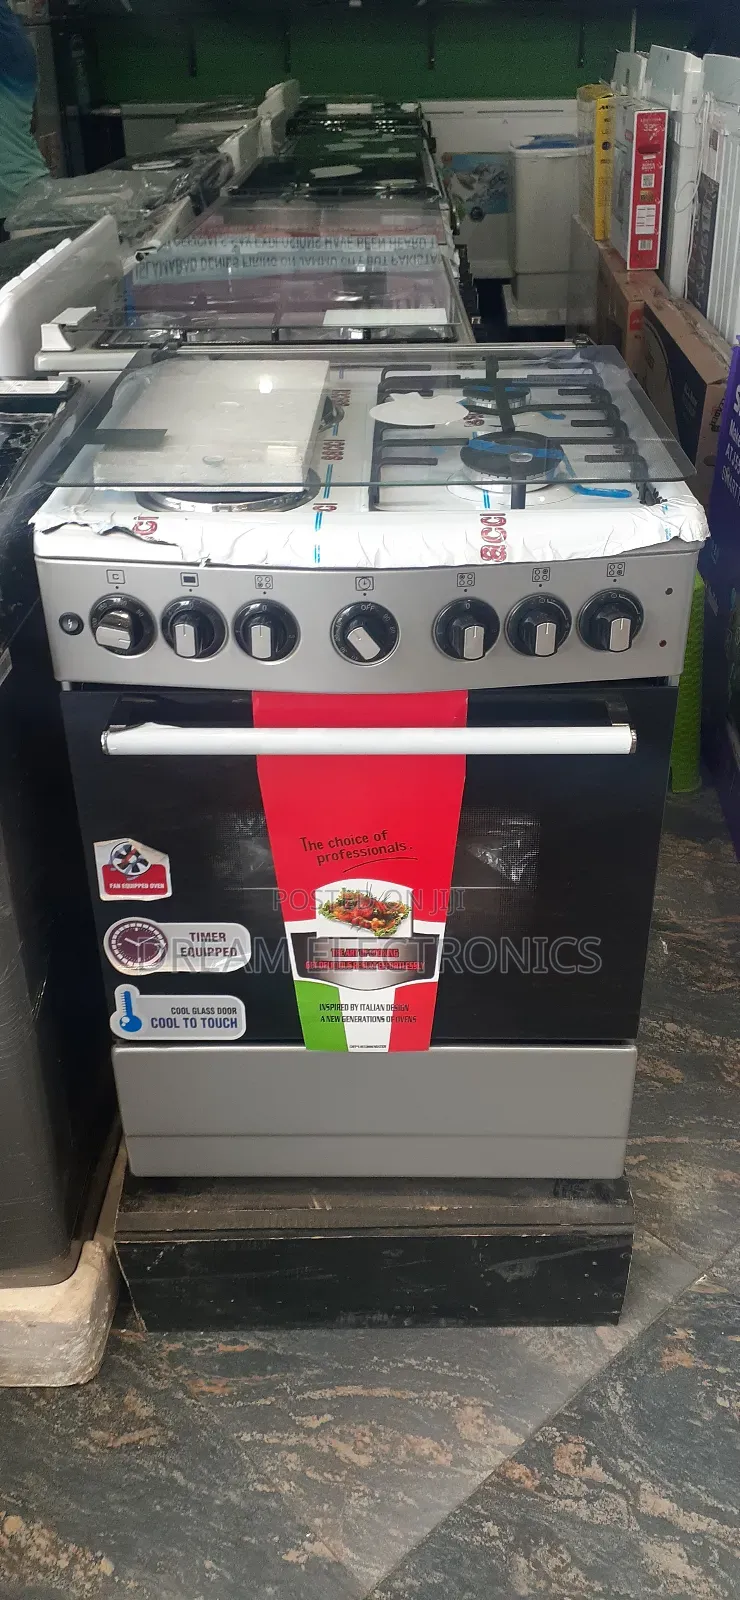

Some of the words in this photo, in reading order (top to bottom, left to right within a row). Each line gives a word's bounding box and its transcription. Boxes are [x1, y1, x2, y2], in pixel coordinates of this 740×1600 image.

[360, 603, 376, 612] OFF
[300, 836, 324, 852] The
[328, 834, 369, 849] choice
[374, 829, 388, 841] of
[189, 931, 227, 942] TIMER
[180, 946, 238, 958] EQUIPPED
[170, 1007, 190, 1015] COOL
[192, 1007, 215, 1015] GLASS
[217, 1007, 237, 1015] DOOR
[319, 1003, 349, 1012] INSPIRED
[350, 1003, 359, 1012] BY
[360, 1003, 385, 1012] ITALIAN
[386, 1003, 409, 1012] DESIGN
[151, 1017, 180, 1029] COOL
[182, 1017, 198, 1029] TO
[201, 1017, 238, 1029] TOUCH
[320, 1015, 326, 1023] A
[326, 1015, 340, 1023] NEW
[341, 1015, 385, 1023] GENERATIONS
[386, 1015, 394, 1023] OF
[395, 1015, 417, 1023] OVENS
